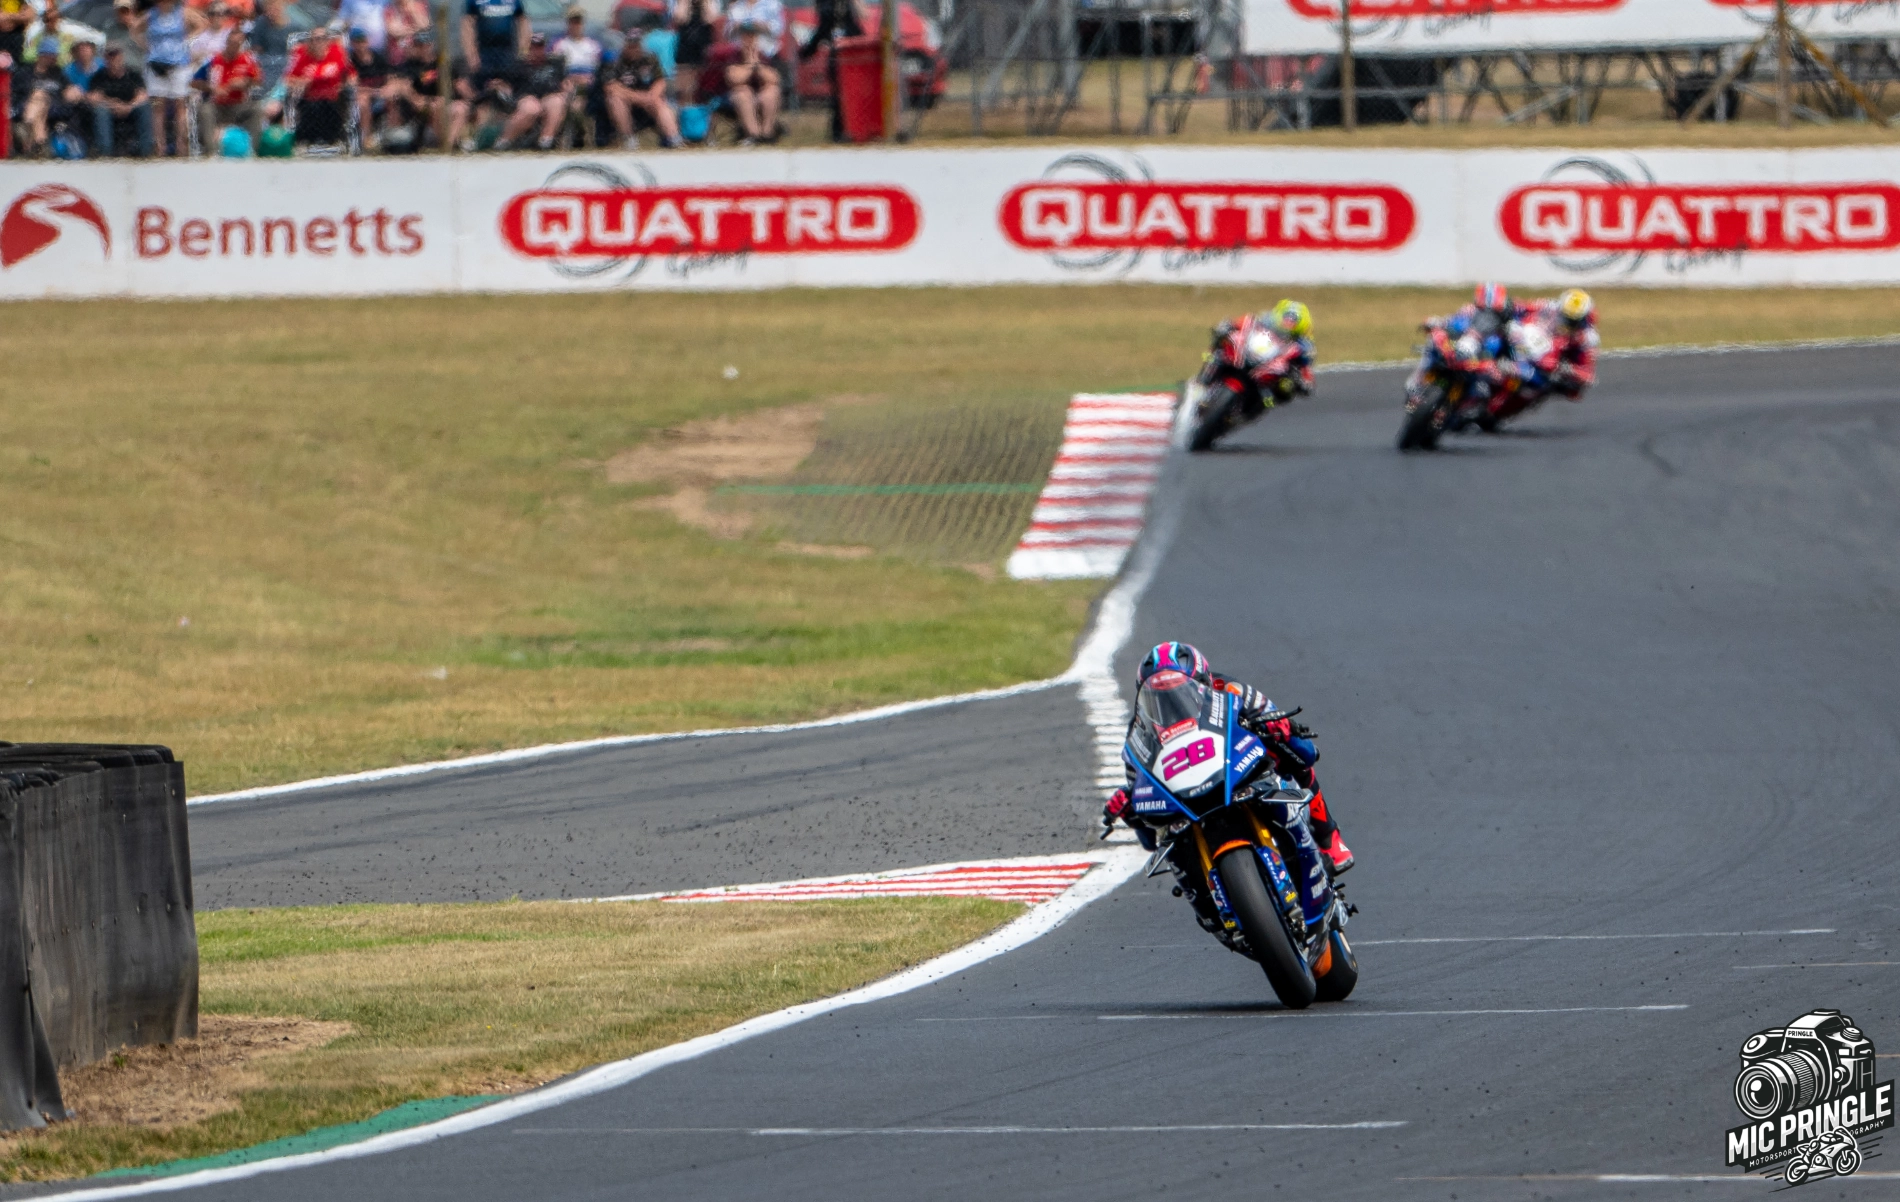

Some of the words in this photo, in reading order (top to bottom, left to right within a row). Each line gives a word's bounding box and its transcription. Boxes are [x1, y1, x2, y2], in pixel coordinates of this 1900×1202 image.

[134, 204, 425, 259] Bennetts
[521, 194, 891, 252] QUATTRO
[1020, 188, 1389, 246] QUATTRO
[1521, 189, 1888, 248] QUATTRO
[1161, 736, 1216, 782] 28
[1234, 745, 1264, 773] YAMAHA
[1135, 800, 1167, 813] YAMAHA
